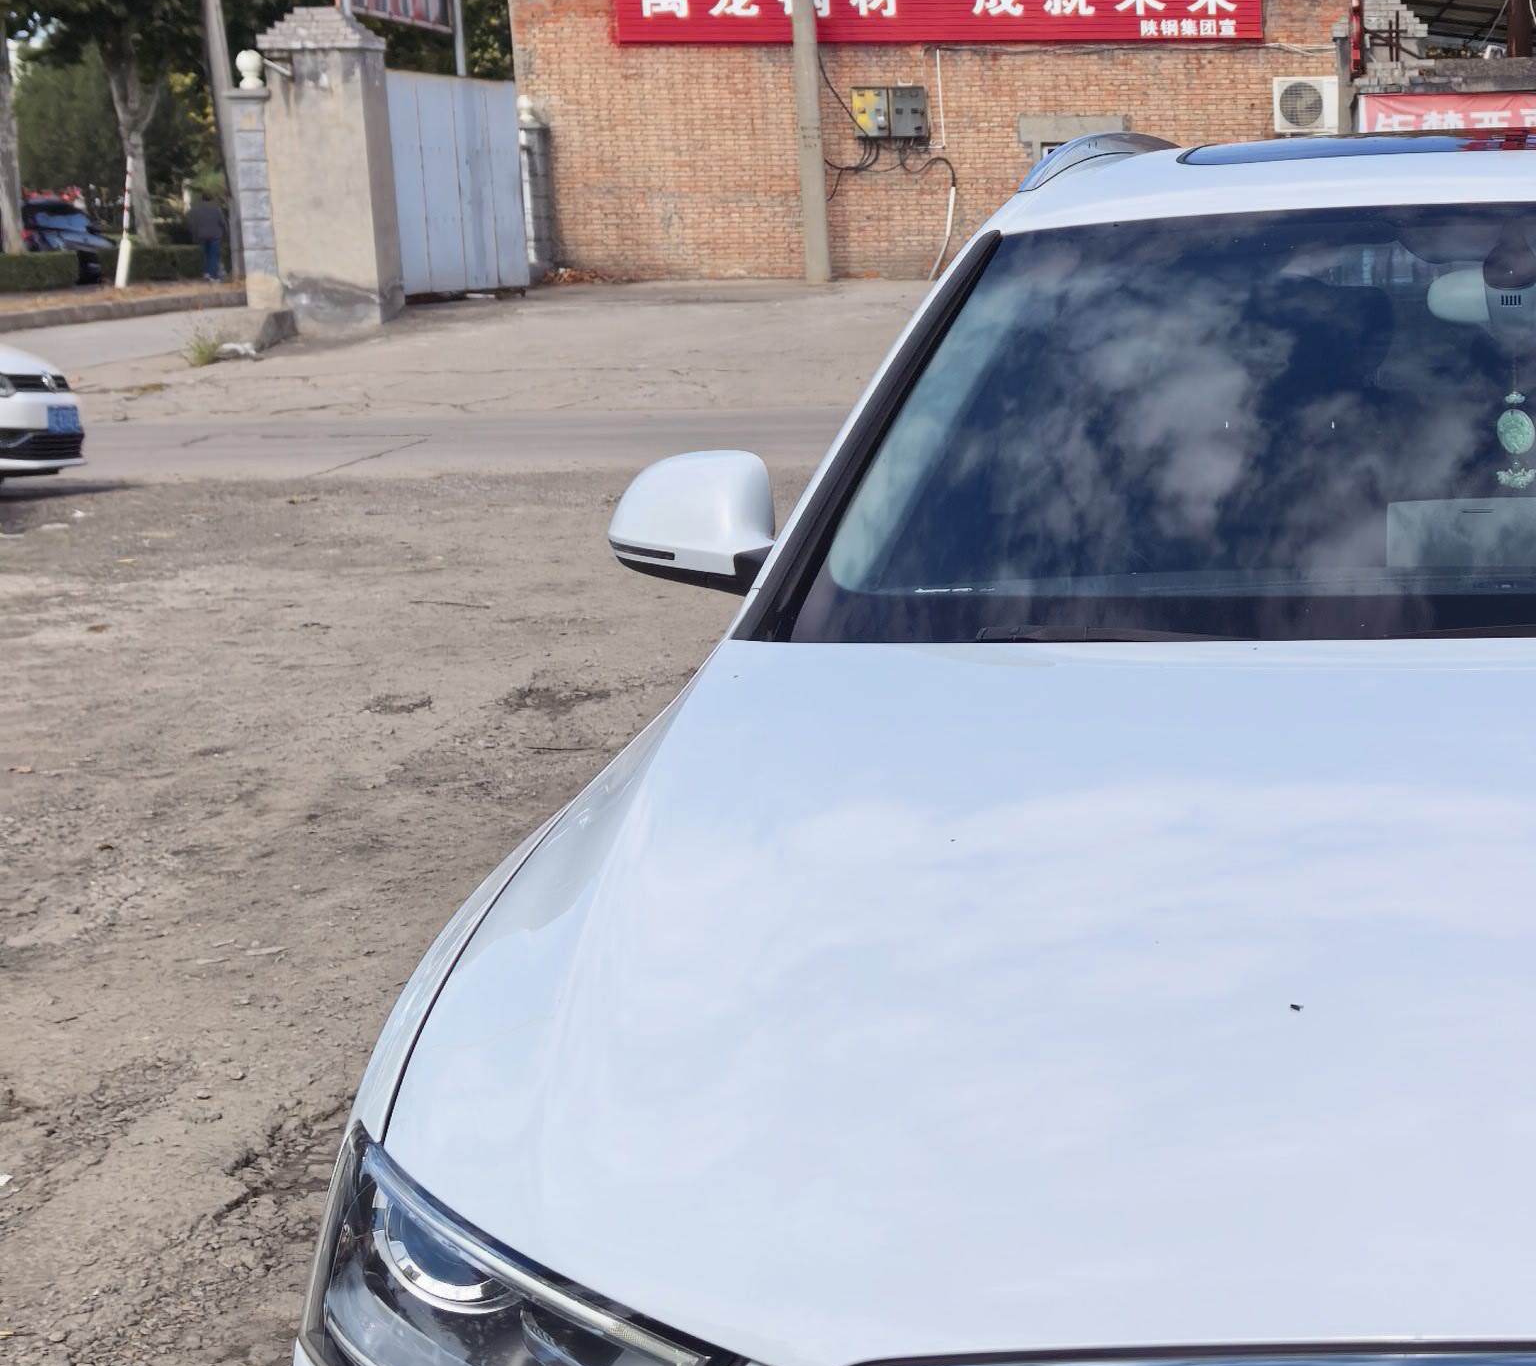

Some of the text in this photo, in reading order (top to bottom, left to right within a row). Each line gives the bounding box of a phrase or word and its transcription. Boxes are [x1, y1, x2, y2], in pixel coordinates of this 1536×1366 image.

[1139, 18, 1238, 37] 陕钢集团宣
